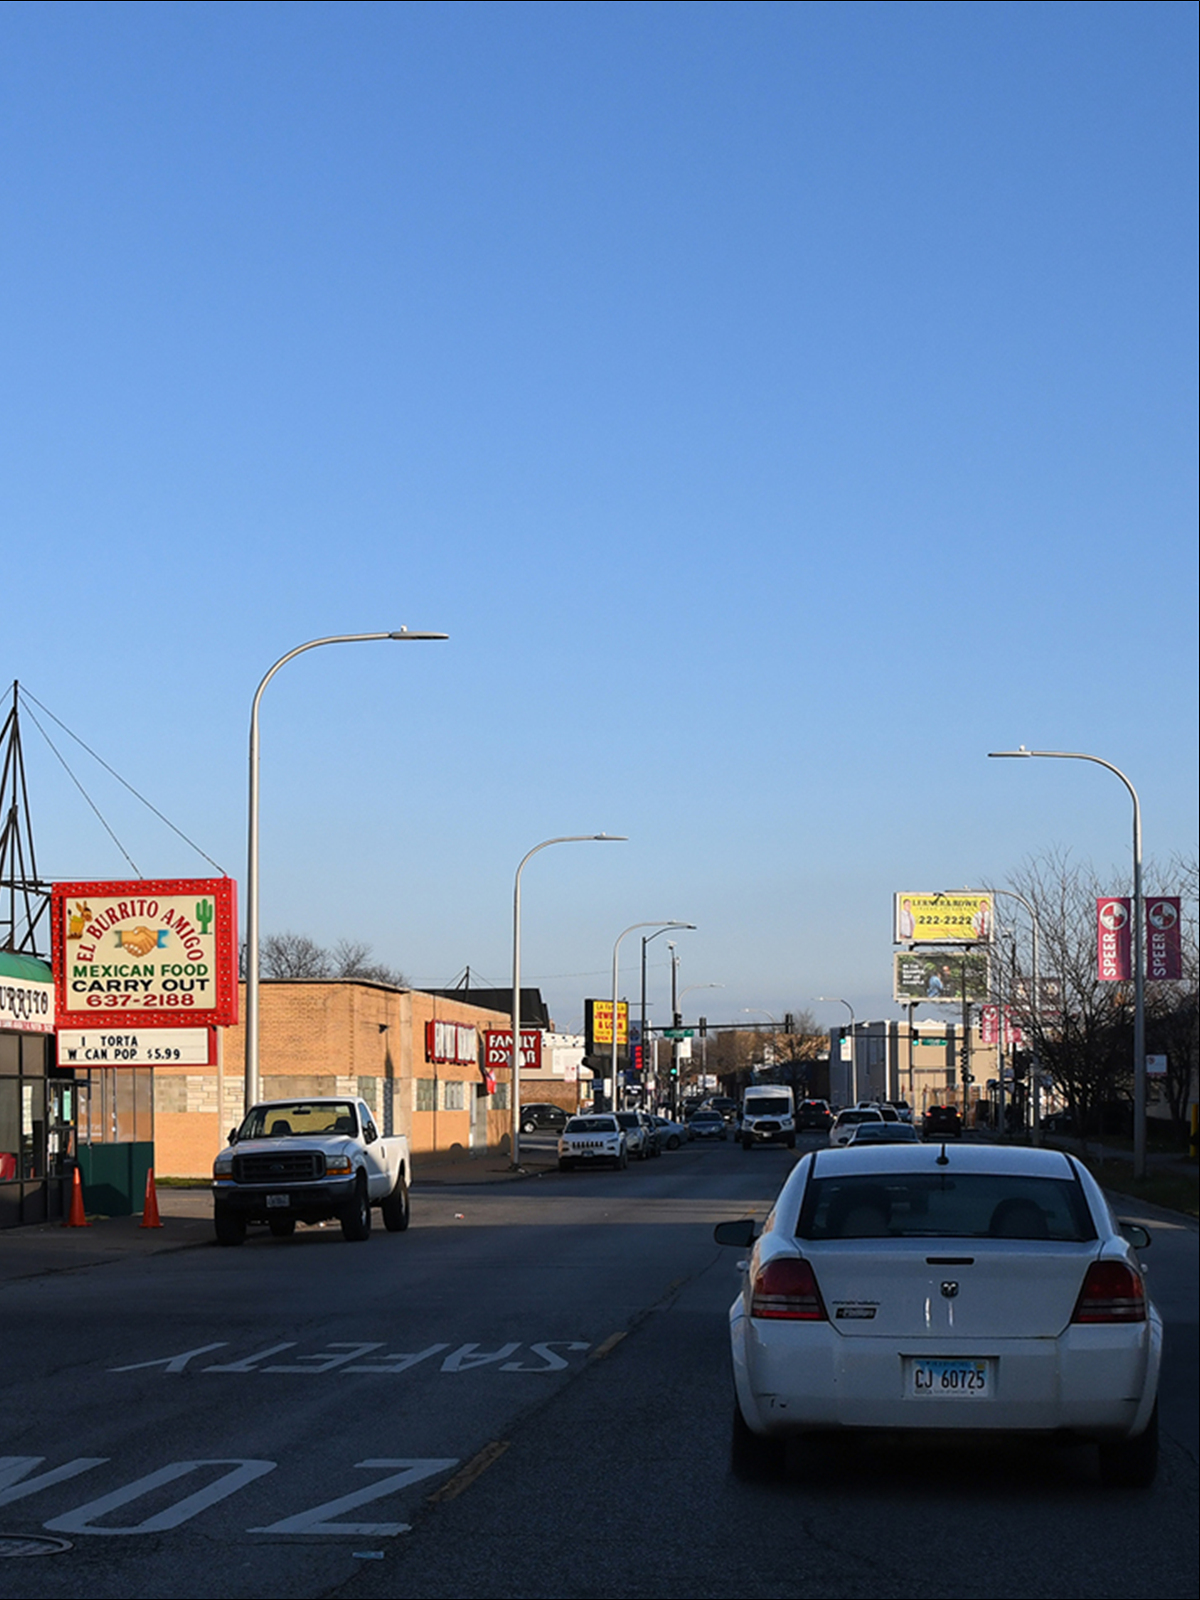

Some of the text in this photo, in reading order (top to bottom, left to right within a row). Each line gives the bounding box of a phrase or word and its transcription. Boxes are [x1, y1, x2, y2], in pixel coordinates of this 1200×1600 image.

[919, 915, 972, 925] 222-2222
[76, 899, 205, 963] EL BURRITO AMIGO
[1102, 933, 1117, 977] SPEER
[1152, 933, 1167, 977] SPEER
[72, 963, 208, 978] MEXICAN FOOD
[72, 978, 210, 992] CARRY OUT
[86, 993, 195, 1007] 637-2188
[100, 1035, 138, 1047] TORTA
[85, 1048, 108, 1060] CAN
[114, 1048, 138, 1059] POP
[147, 1048, 181, 1060] $5.99
[108, 1340, 591, 1374] SAFETY
[915, 1369, 985, 1390] CJ 60725
